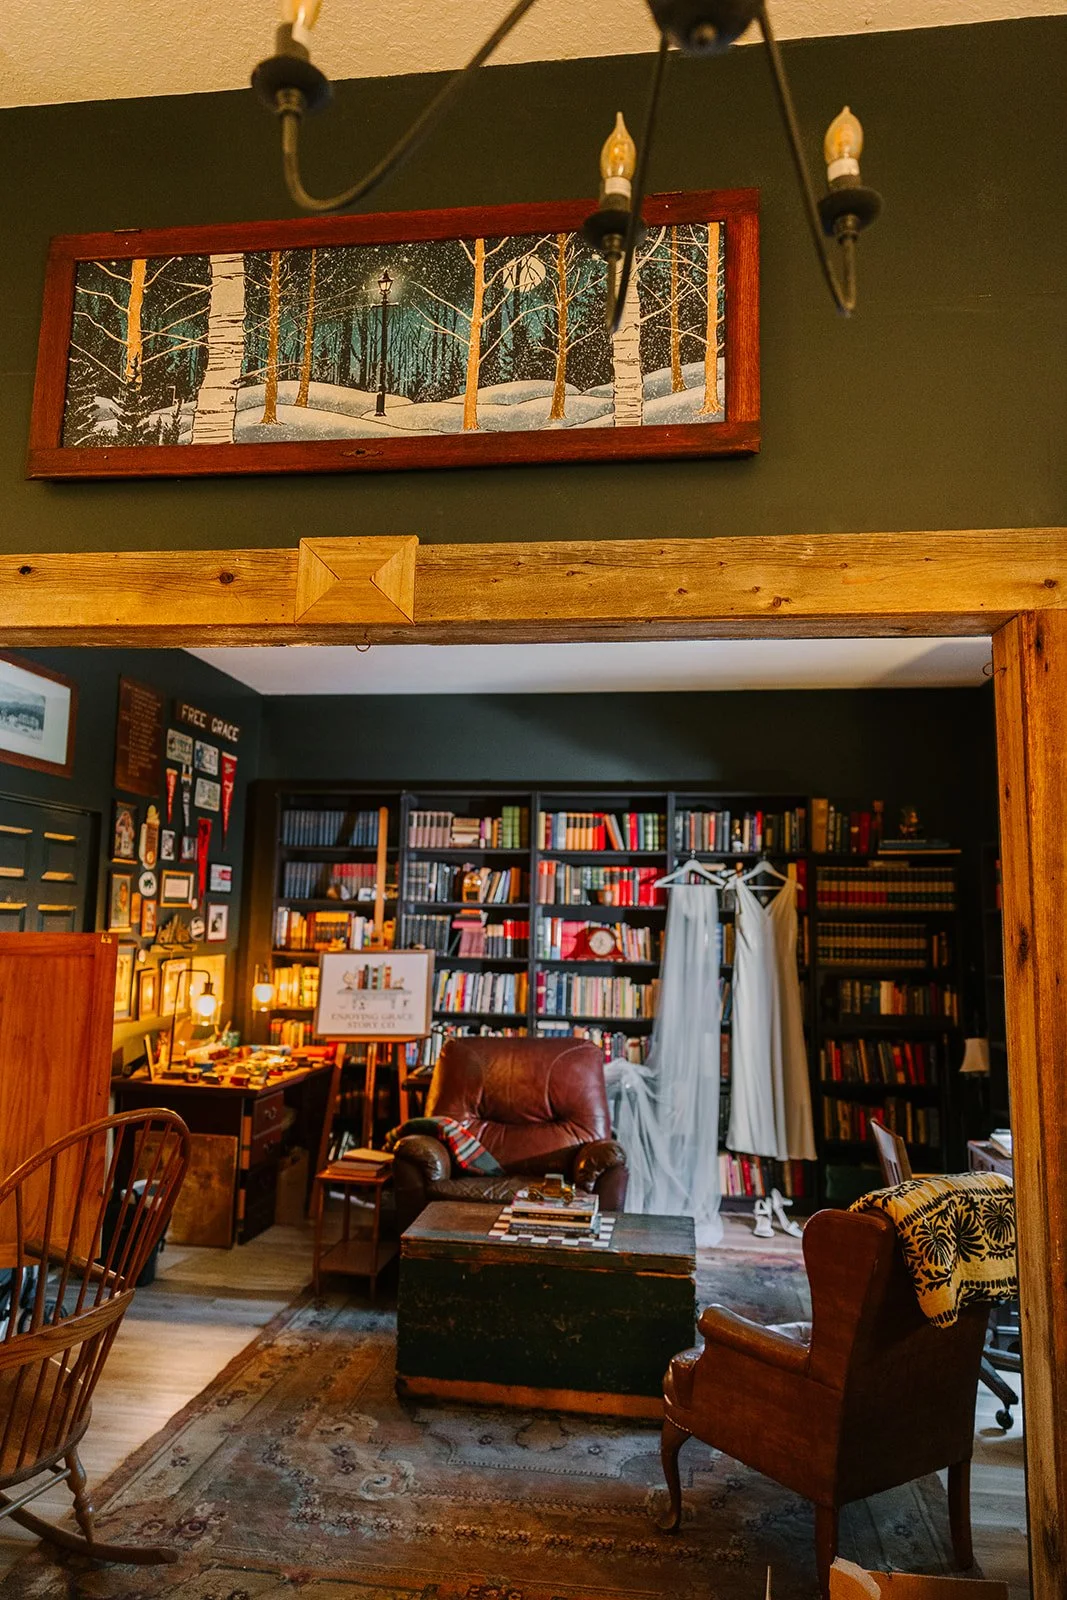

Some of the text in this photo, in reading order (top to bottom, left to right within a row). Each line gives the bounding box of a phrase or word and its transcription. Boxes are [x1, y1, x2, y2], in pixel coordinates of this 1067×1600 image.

[181, 704, 240, 742] FREE GRACE
[381, 1013, 413, 1021] GRACE
